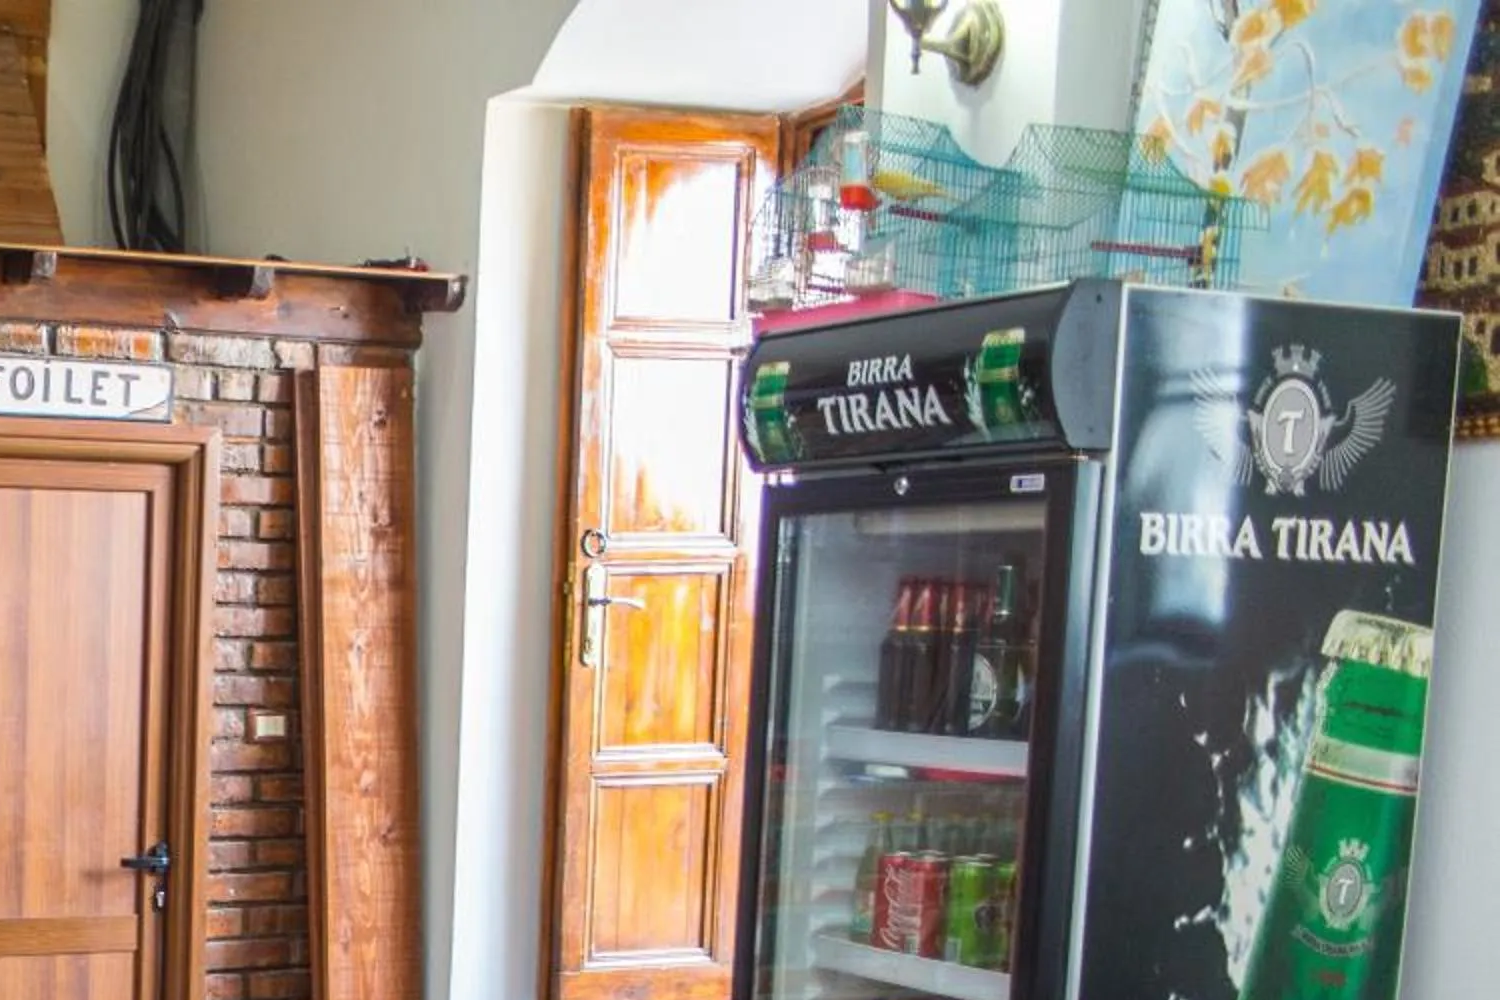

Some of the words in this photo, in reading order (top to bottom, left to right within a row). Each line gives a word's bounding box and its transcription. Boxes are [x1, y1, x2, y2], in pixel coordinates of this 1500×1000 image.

[847, 353, 914, 387] BIRRA
[817, 384, 953, 435] TIRANA
[1139, 512, 1263, 560] BIRRA
[1272, 515, 1415, 564] TIRANA
